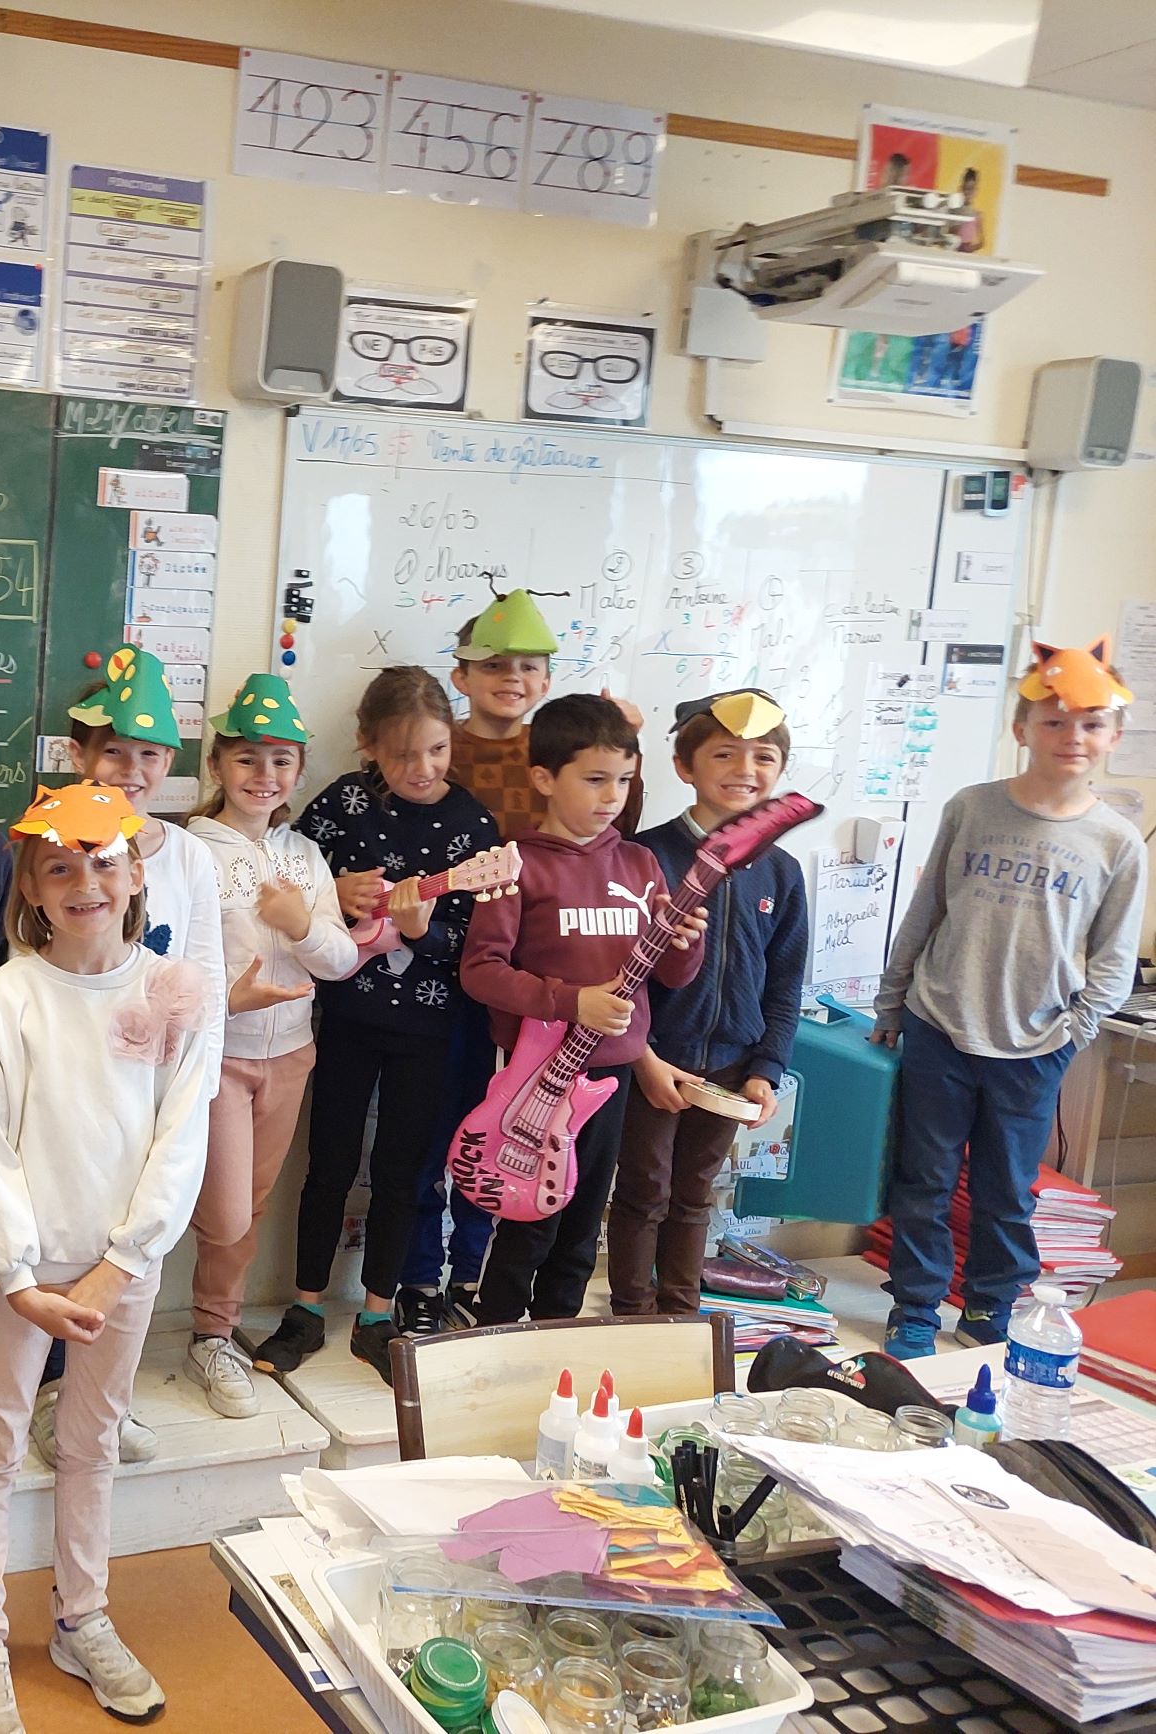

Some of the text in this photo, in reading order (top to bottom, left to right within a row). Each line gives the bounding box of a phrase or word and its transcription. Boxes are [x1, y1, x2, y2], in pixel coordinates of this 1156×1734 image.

[361, 338, 380, 351] NE
[963, 850, 1084, 900] KAPORAL
[558, 907, 640, 937] PUMA
[452, 1128, 487, 1193] ROCK
